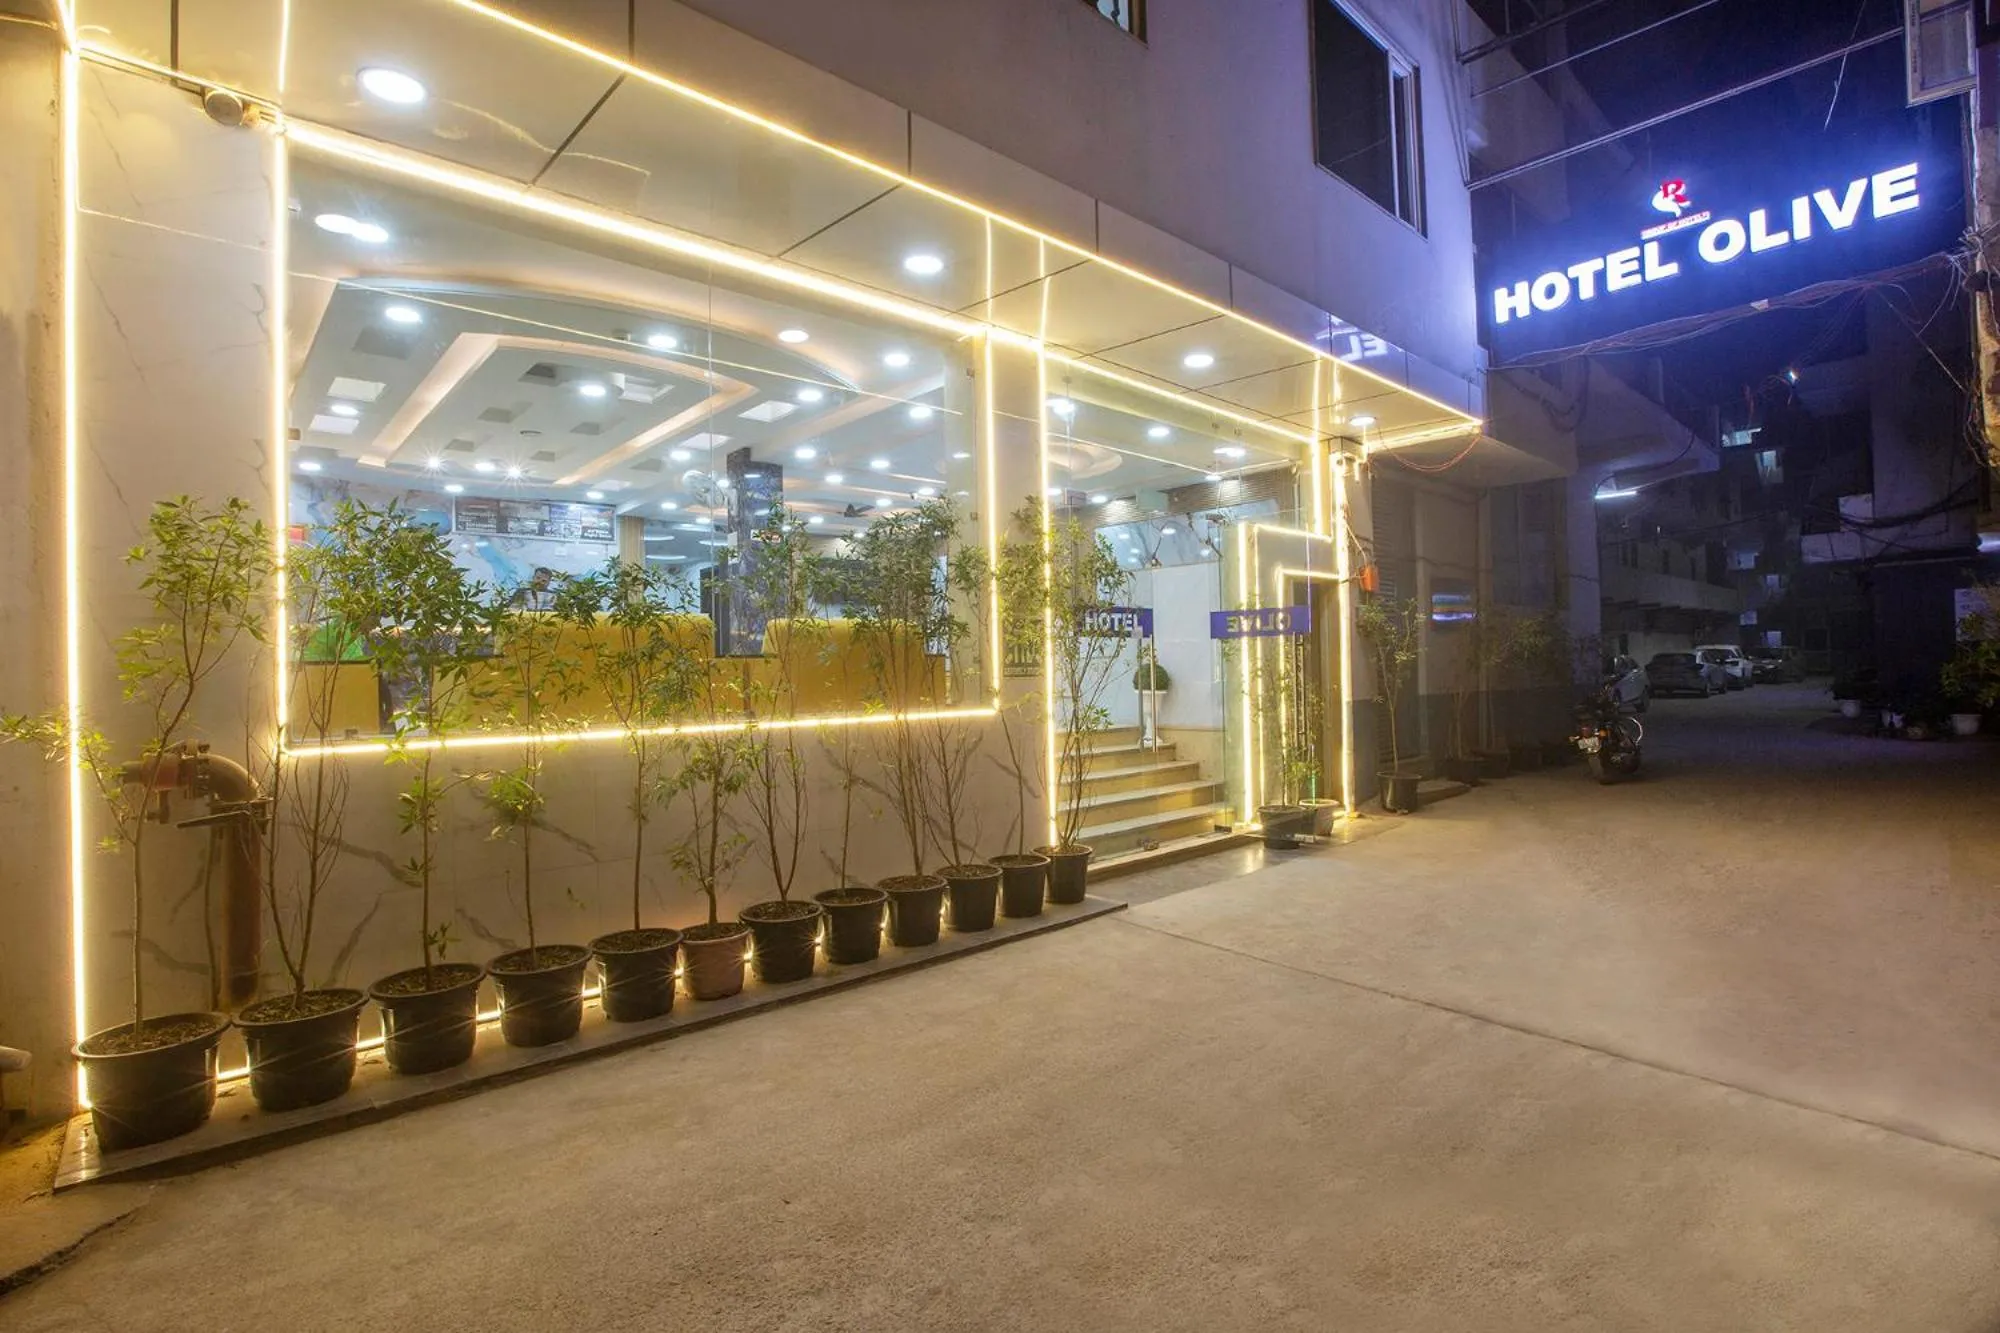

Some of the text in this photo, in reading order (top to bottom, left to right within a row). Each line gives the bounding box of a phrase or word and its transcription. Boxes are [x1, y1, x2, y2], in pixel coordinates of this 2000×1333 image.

[1493, 162, 1920, 324] HOTEL OLIVE
[1084, 610, 1142, 633] HOTEL
